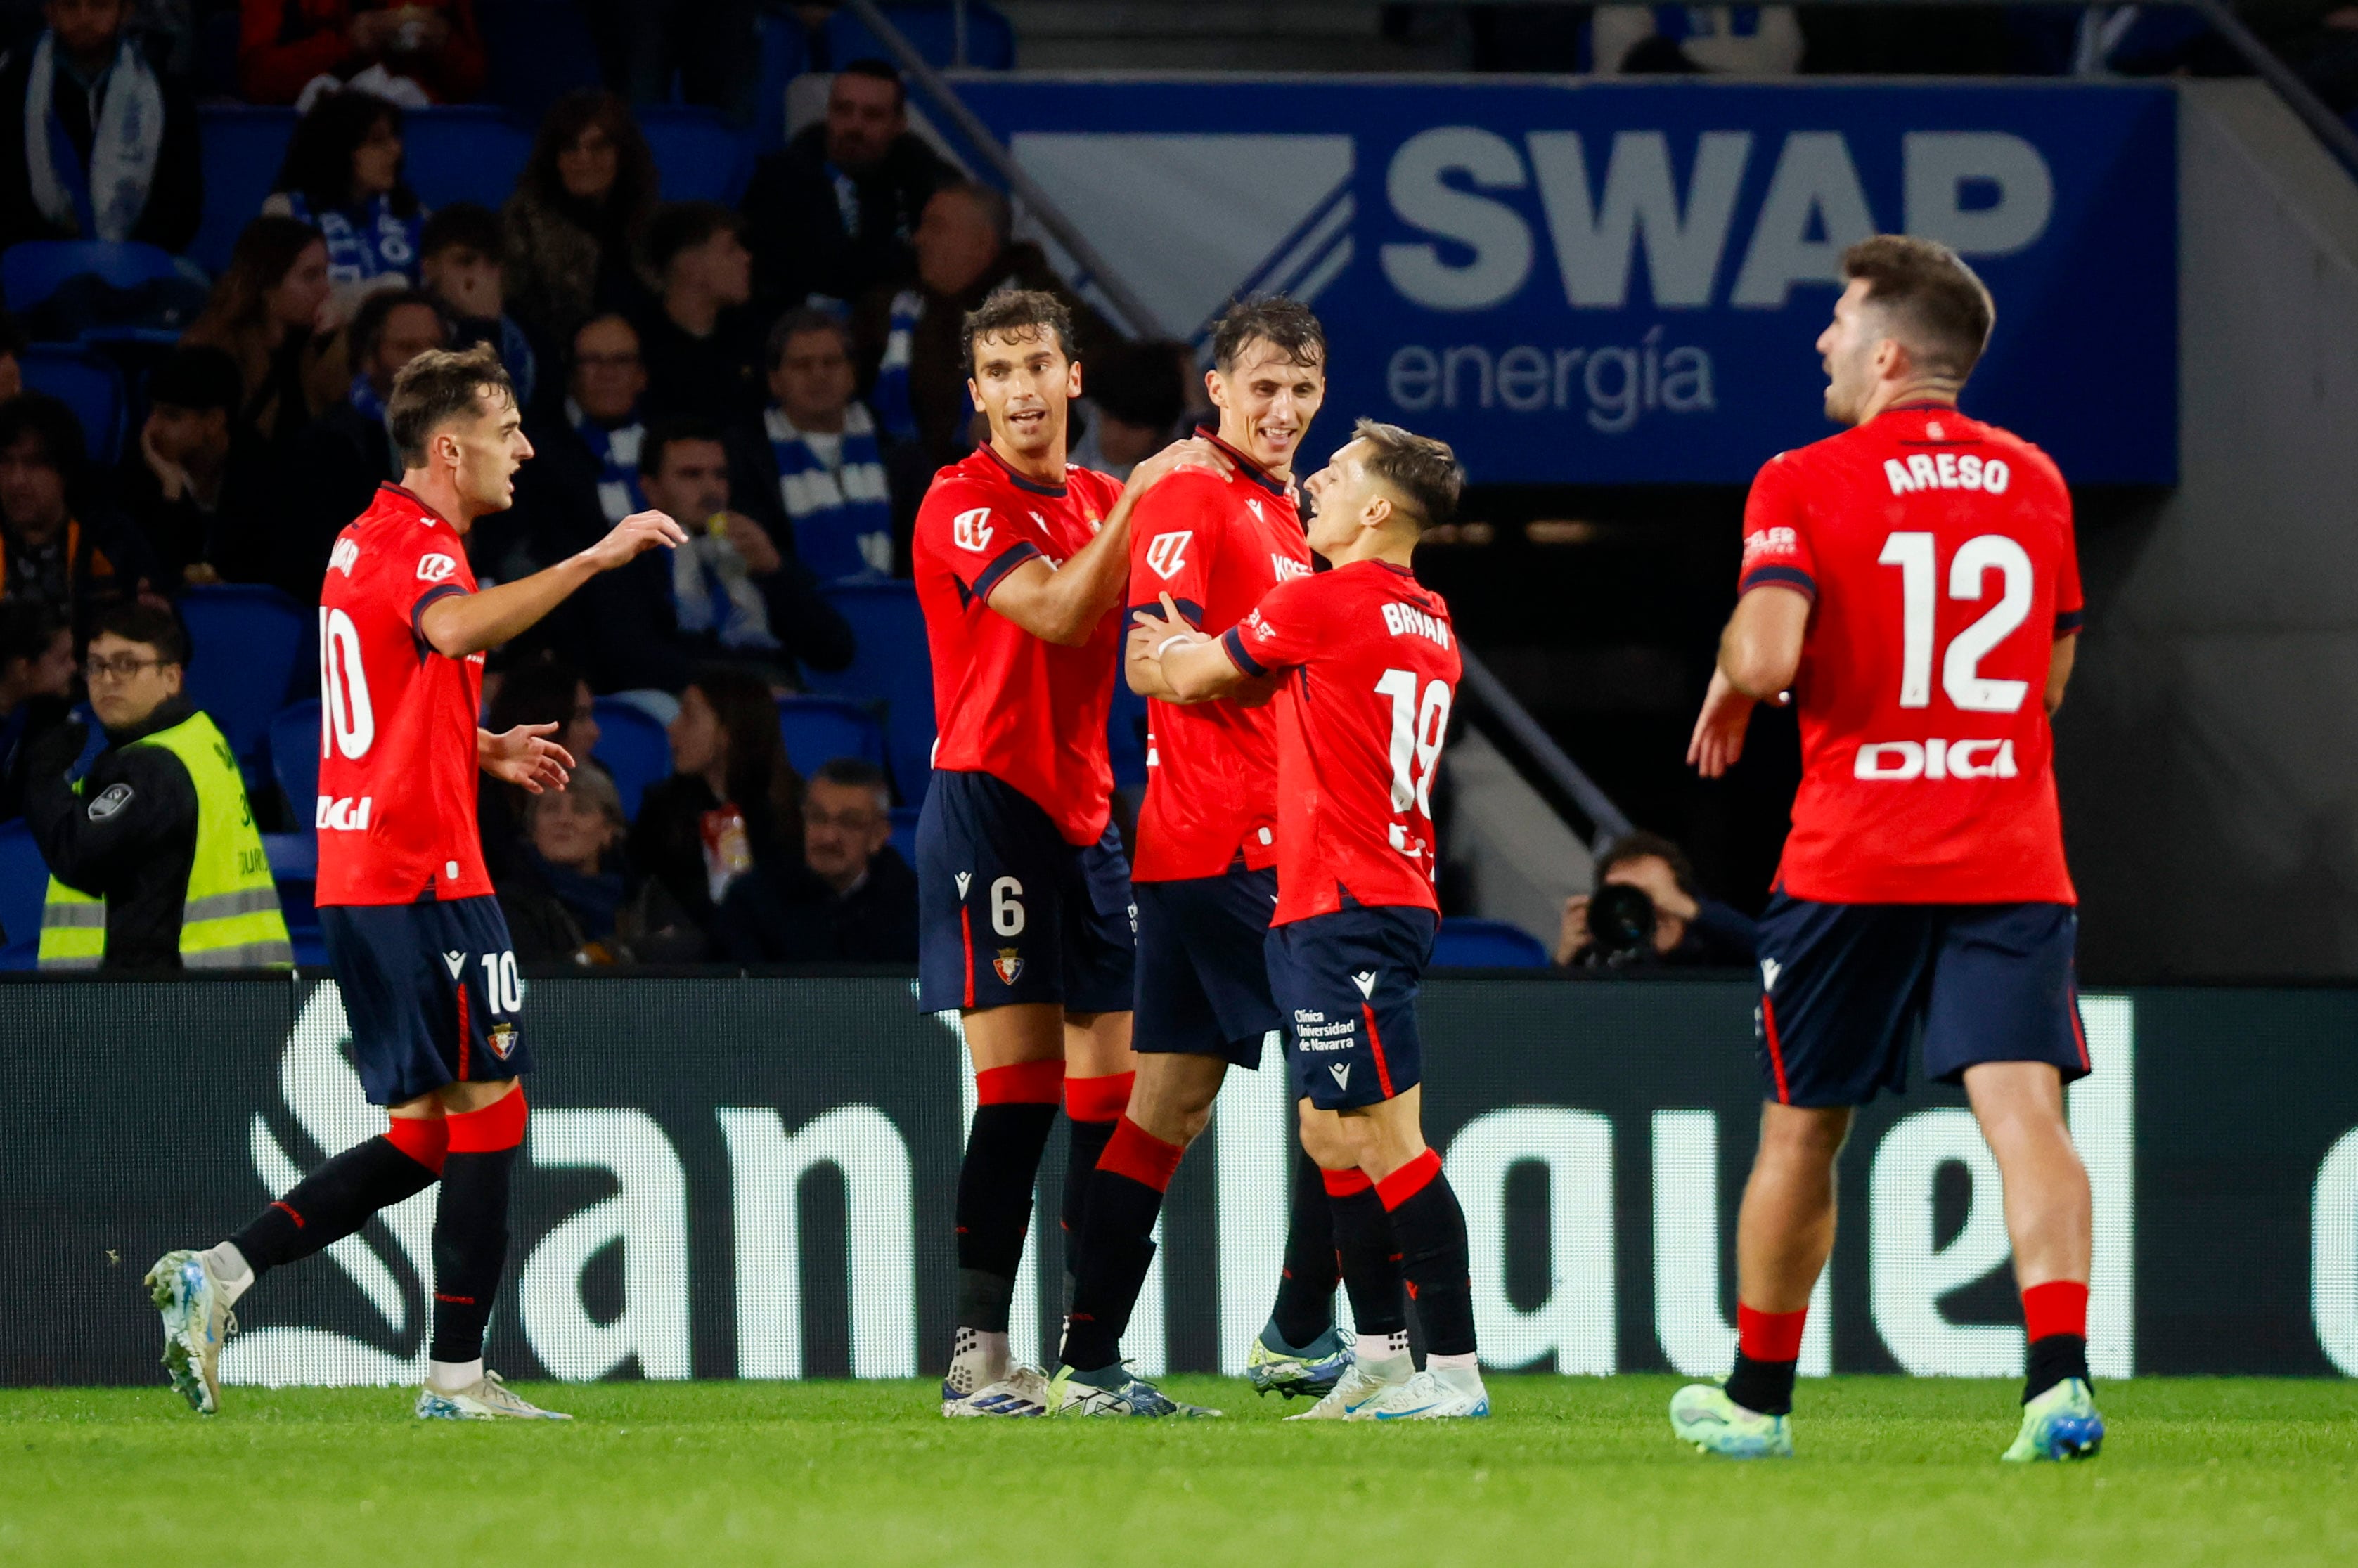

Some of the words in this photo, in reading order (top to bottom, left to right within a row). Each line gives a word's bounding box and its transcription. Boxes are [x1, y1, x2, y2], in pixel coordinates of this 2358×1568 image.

[1378, 125, 2057, 313] SWAP
[1386, 323, 1718, 435] energía
[1883, 452, 2011, 497] ARESO
[1381, 602, 1450, 651] BRYAN
[1876, 531, 2035, 713] 12
[1374, 668, 1451, 822] 19
[990, 875, 1025, 937] 6
[480, 950, 522, 1015] 10
[1294, 1009, 1325, 1023] Clínica
[1296, 1019, 1355, 1037] Universidad
[1299, 1039, 1311, 1051] de
[1310, 1037, 1355, 1051] Navarra
[217, 977, 917, 1387] San
